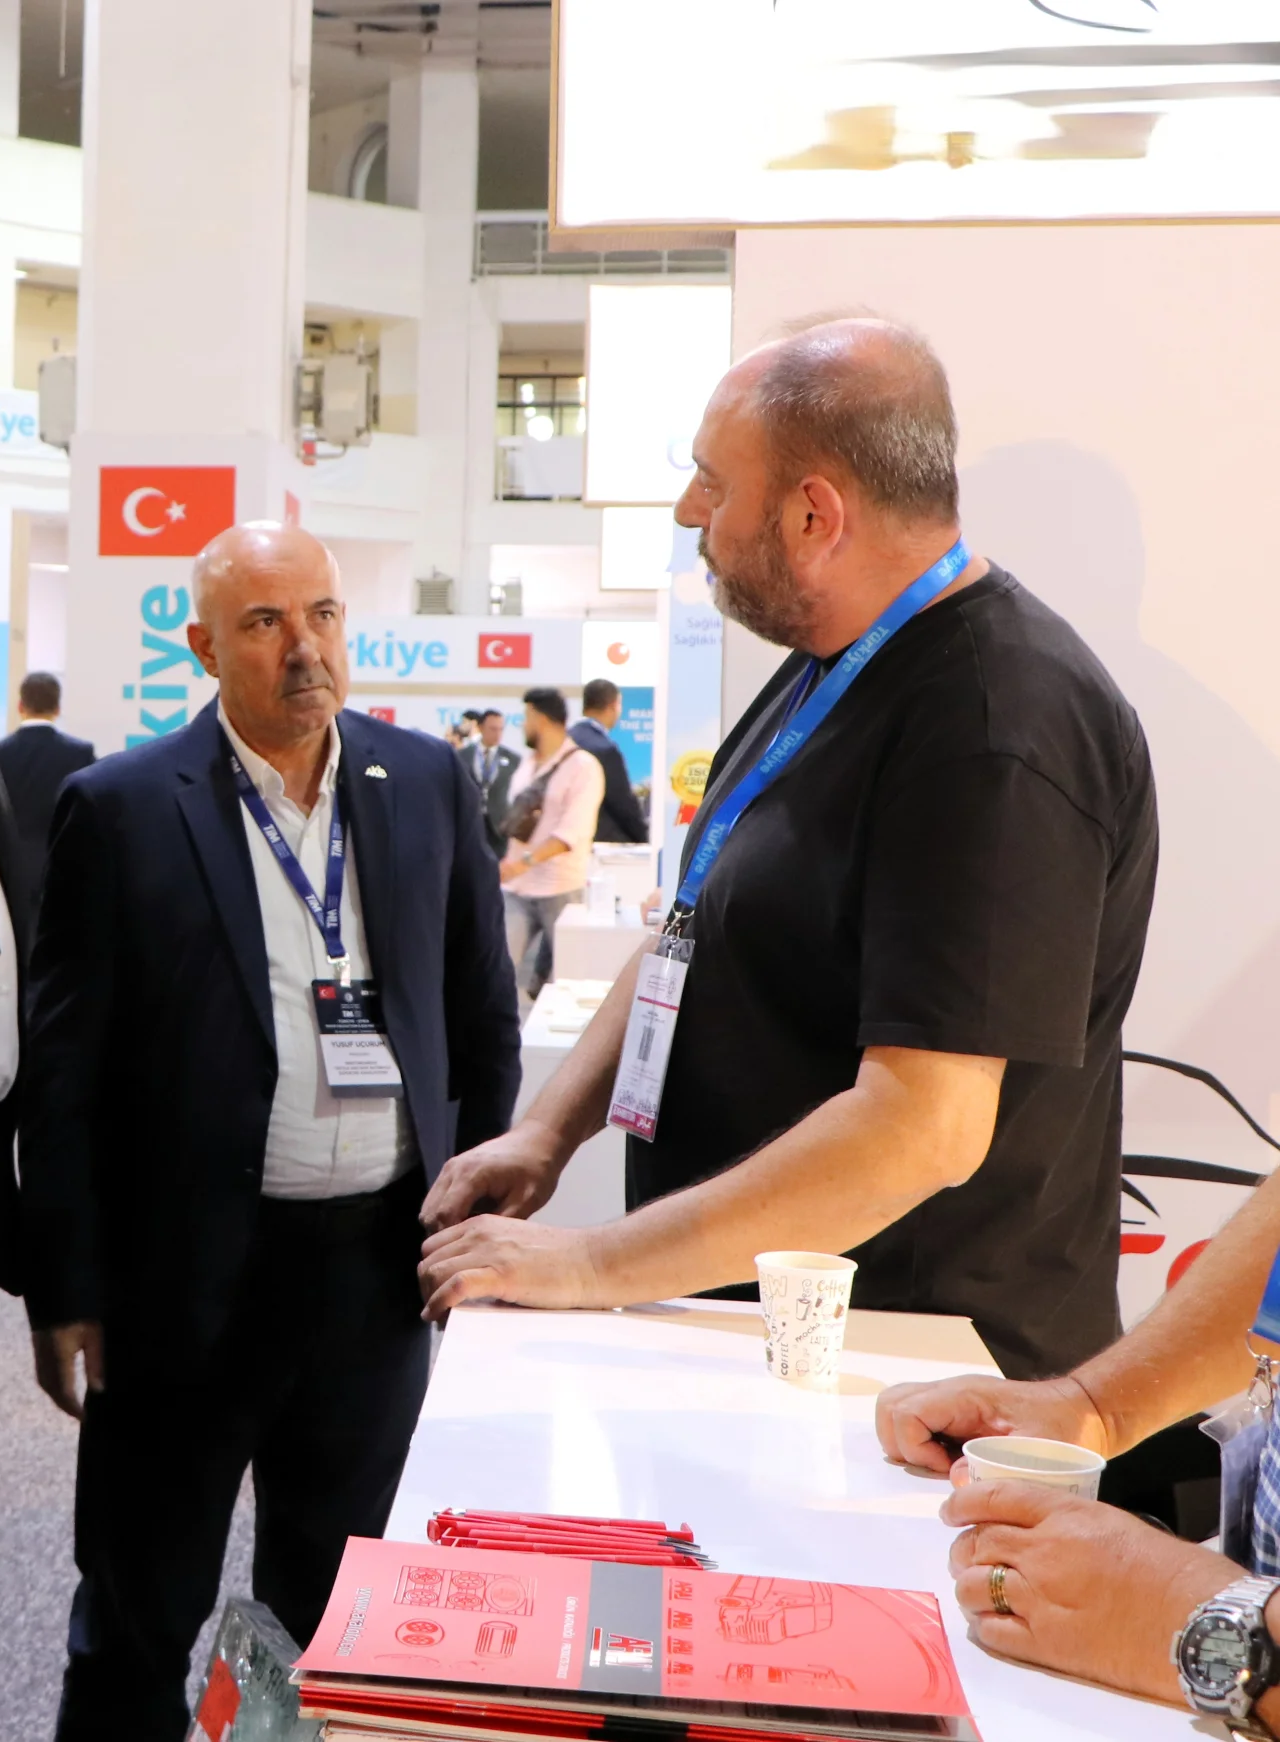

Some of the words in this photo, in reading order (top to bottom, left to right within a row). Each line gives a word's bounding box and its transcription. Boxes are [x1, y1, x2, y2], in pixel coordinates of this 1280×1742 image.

[122, 584, 206, 751] kiye
[347, 630, 449, 677] kiye
[795, 1322, 820, 1342] mocha
[780, 1342, 789, 1376] COFFEE
